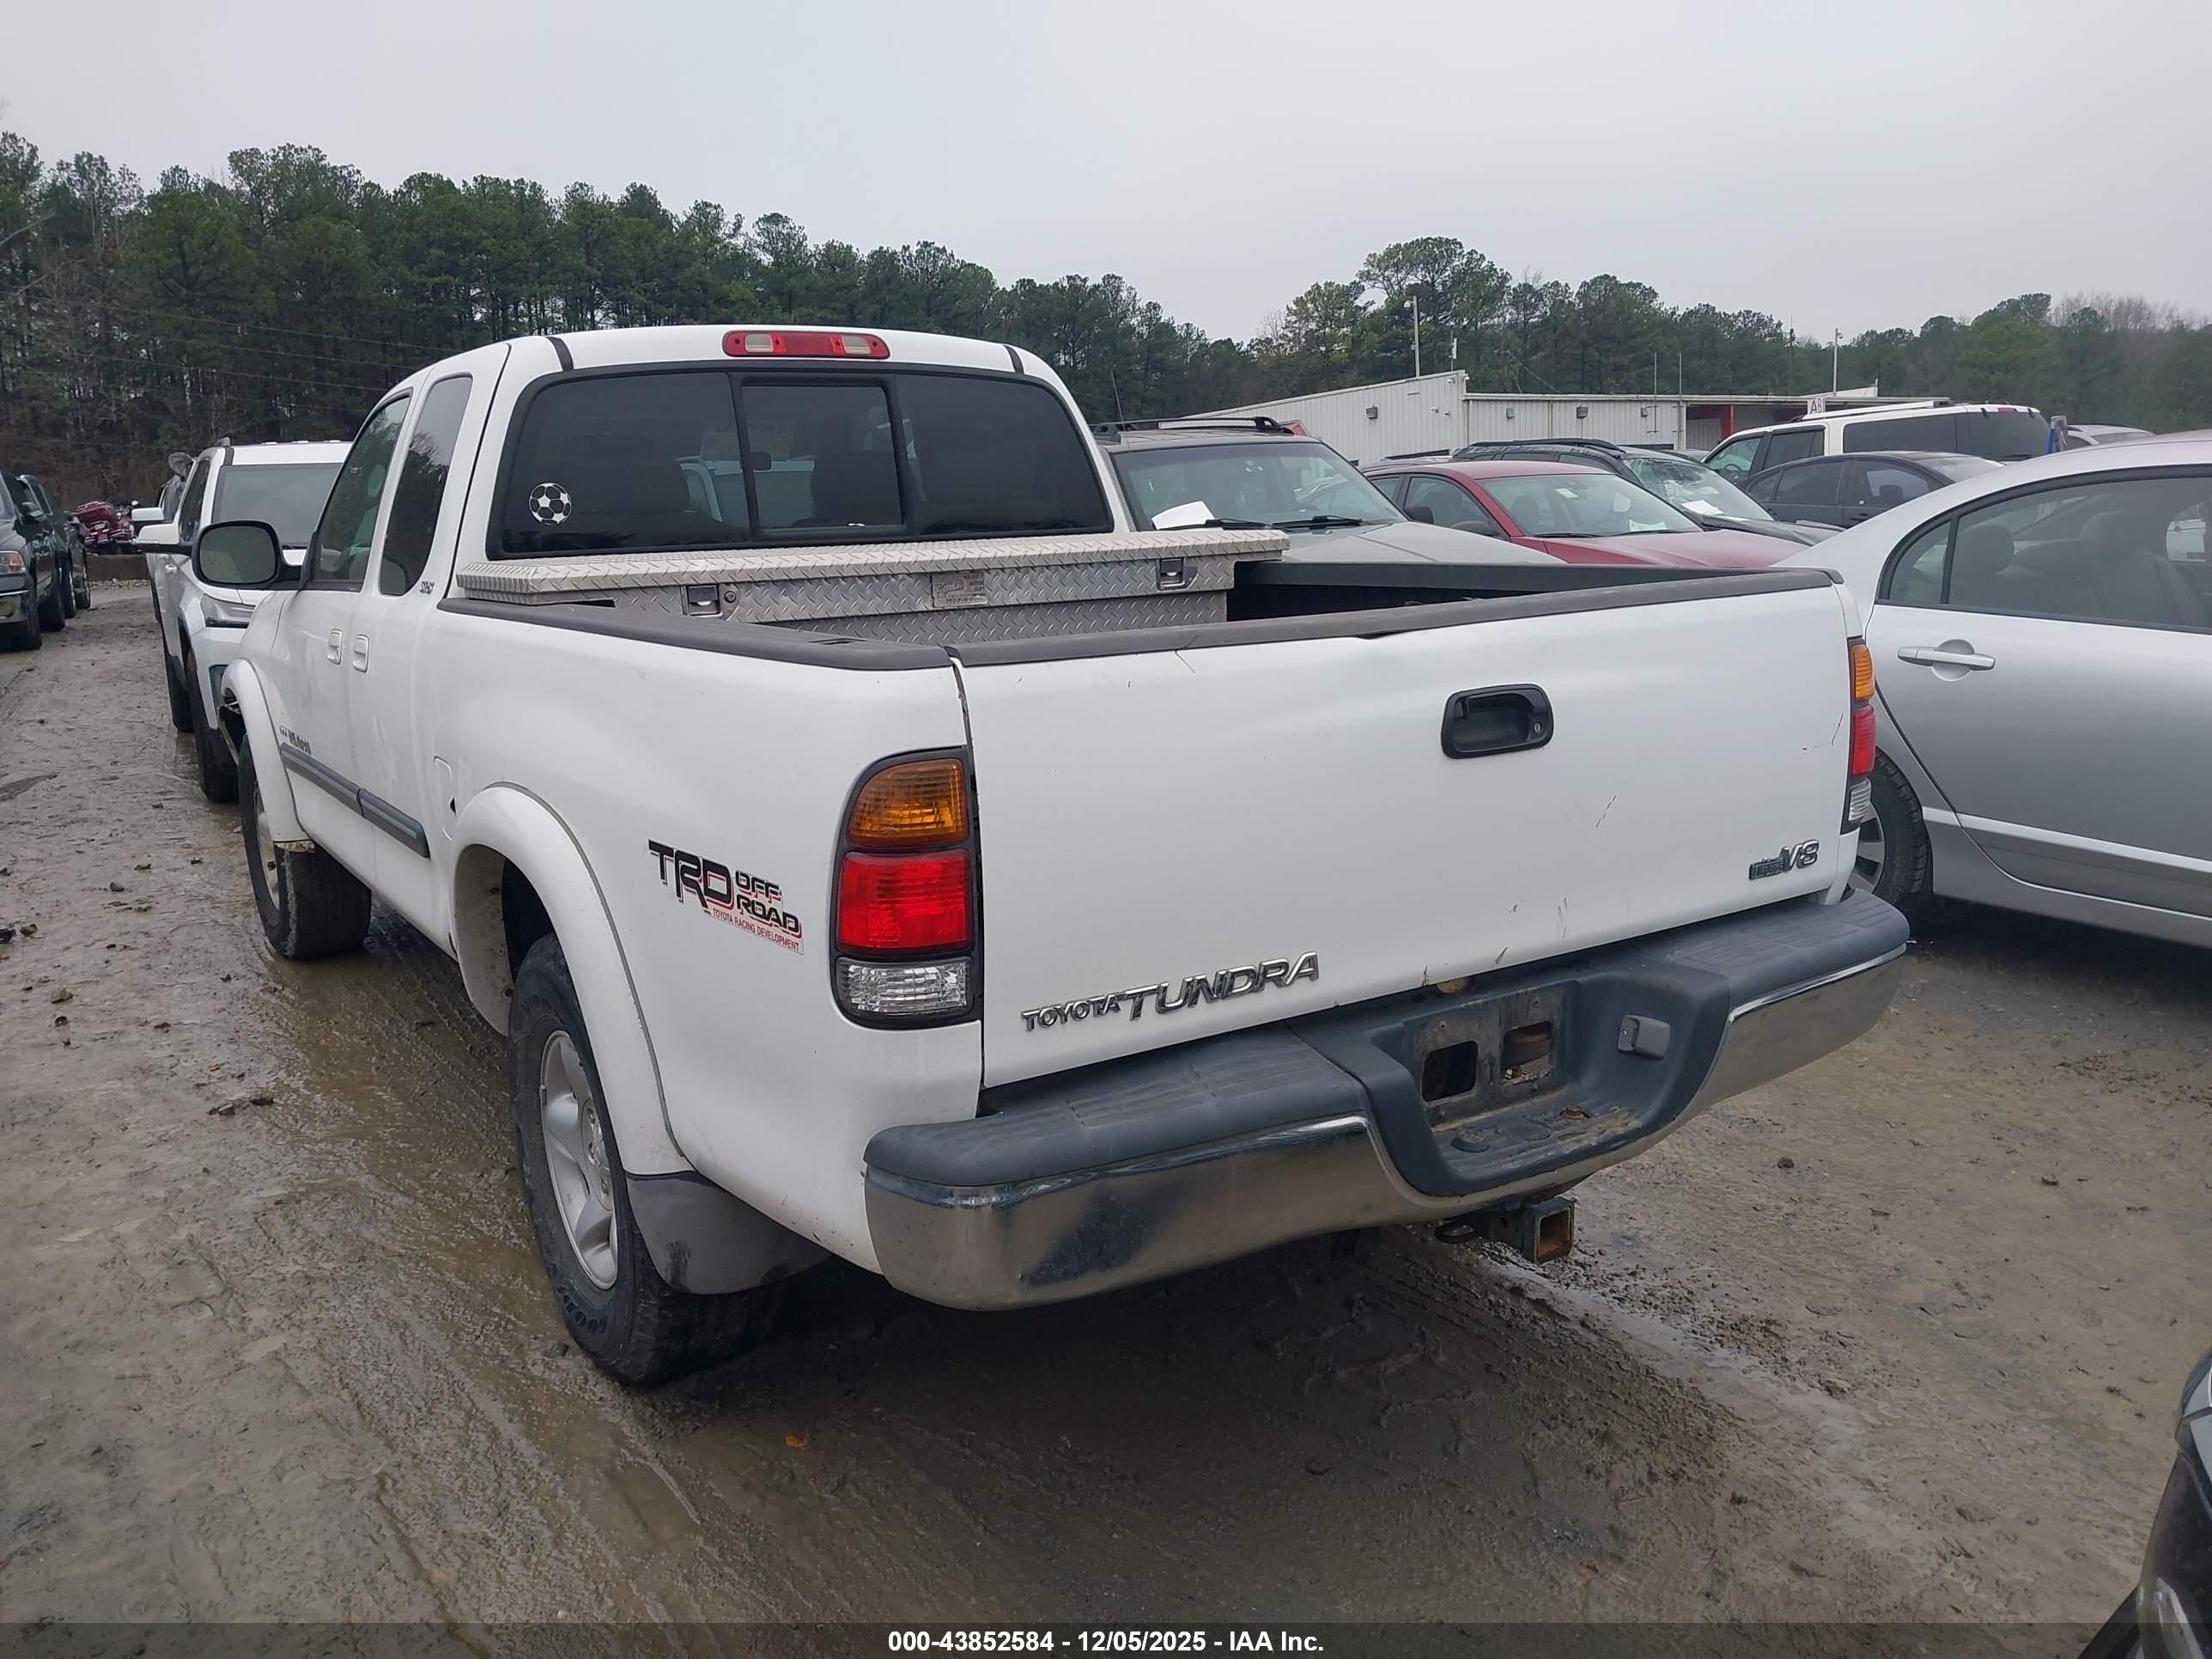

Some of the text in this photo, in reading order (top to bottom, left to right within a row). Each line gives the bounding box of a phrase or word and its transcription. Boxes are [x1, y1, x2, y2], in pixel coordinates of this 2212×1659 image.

[648, 839, 733, 912] TRD
[1782, 839, 1820, 871] V8
[735, 870, 781, 902] OFF
[713, 908, 800, 951] TOYOTA RACING DEVELOPMENT
[737, 894, 803, 939] ROAD
[1021, 951, 1320, 1031] TOYOTA TUNDRA
